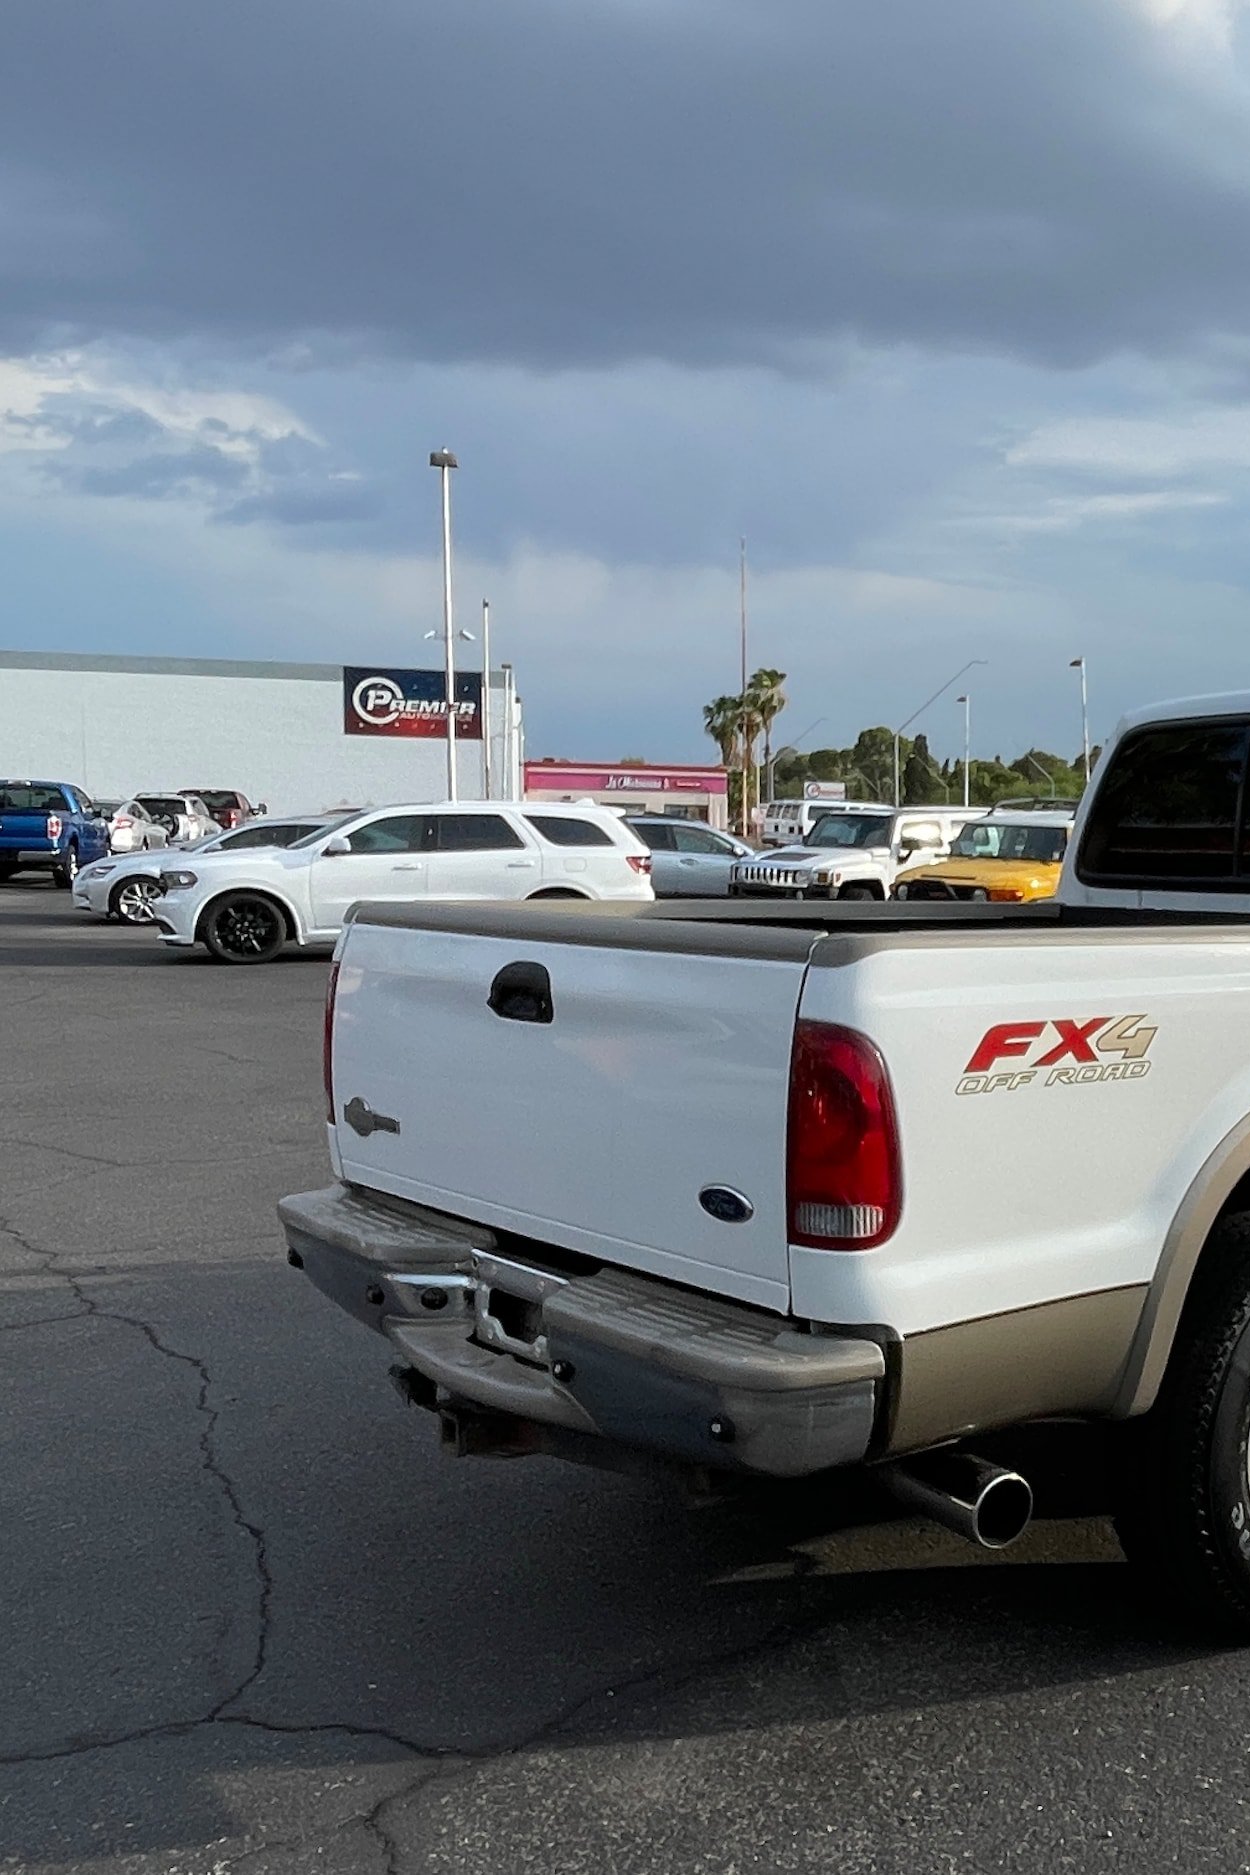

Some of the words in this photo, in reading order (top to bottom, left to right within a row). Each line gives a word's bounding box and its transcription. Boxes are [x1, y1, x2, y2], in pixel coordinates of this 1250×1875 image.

[963, 1014, 1159, 1074] FX4
[955, 1070, 1038, 1096] OFF
[1044, 1060, 1152, 1087] ROAD
